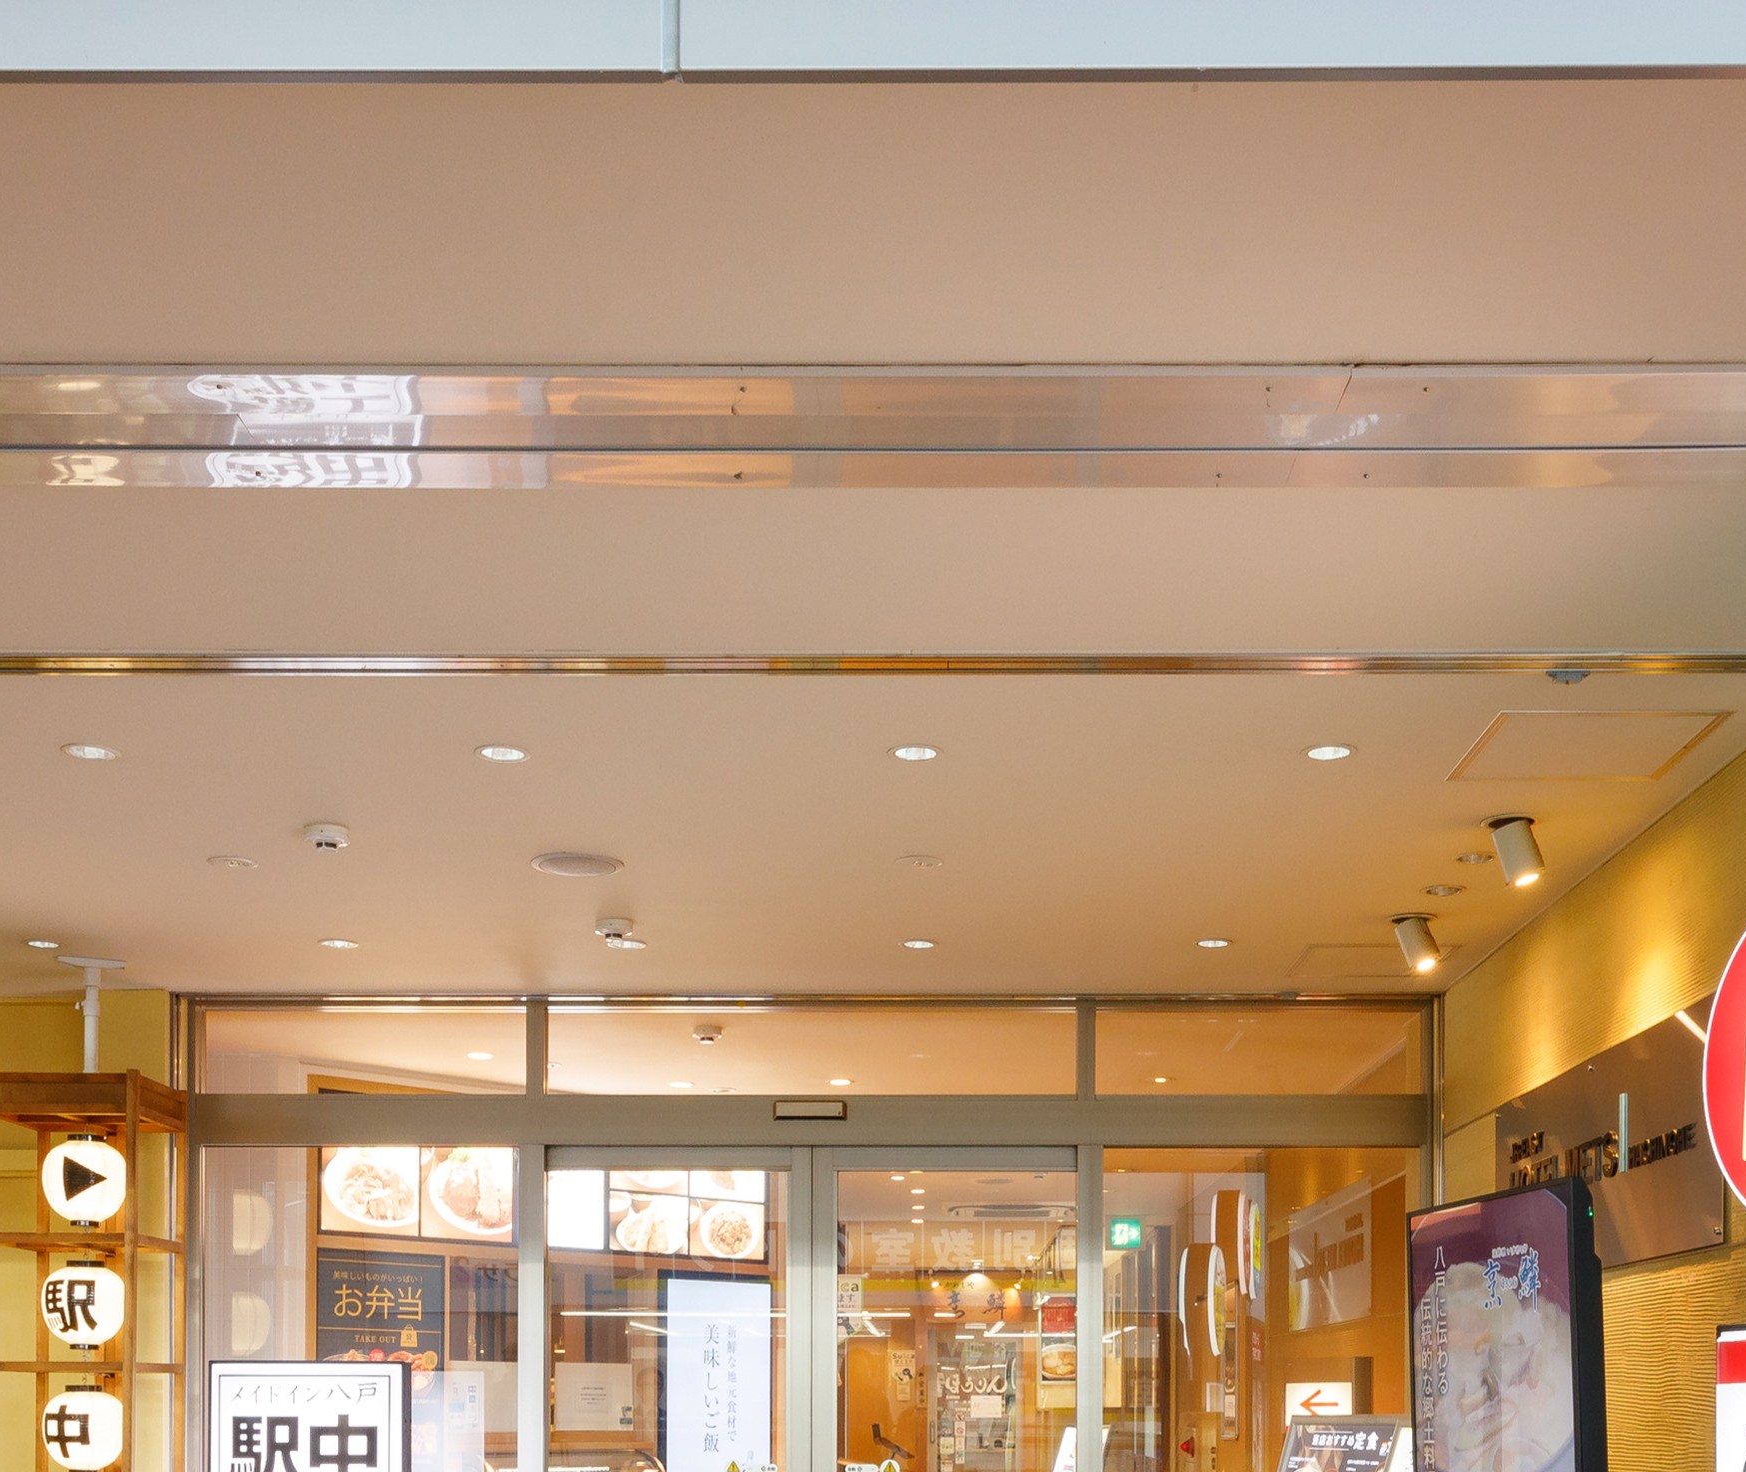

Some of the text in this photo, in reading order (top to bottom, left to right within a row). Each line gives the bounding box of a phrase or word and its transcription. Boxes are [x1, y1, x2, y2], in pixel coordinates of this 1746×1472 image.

[334, 1283, 422, 1321] お弁当
[354, 1334, 376, 1343] TAKE
[379, 1335, 396, 1344] OUT
[1434, 1246, 1449, 1395] 八戸に伝わる
[231, 1382, 378, 1404] メイドイン八戸
[703, 1324, 720, 1453] 美味しいご飯
[726, 1324, 738, 1442] 新鮮な地元食材で
